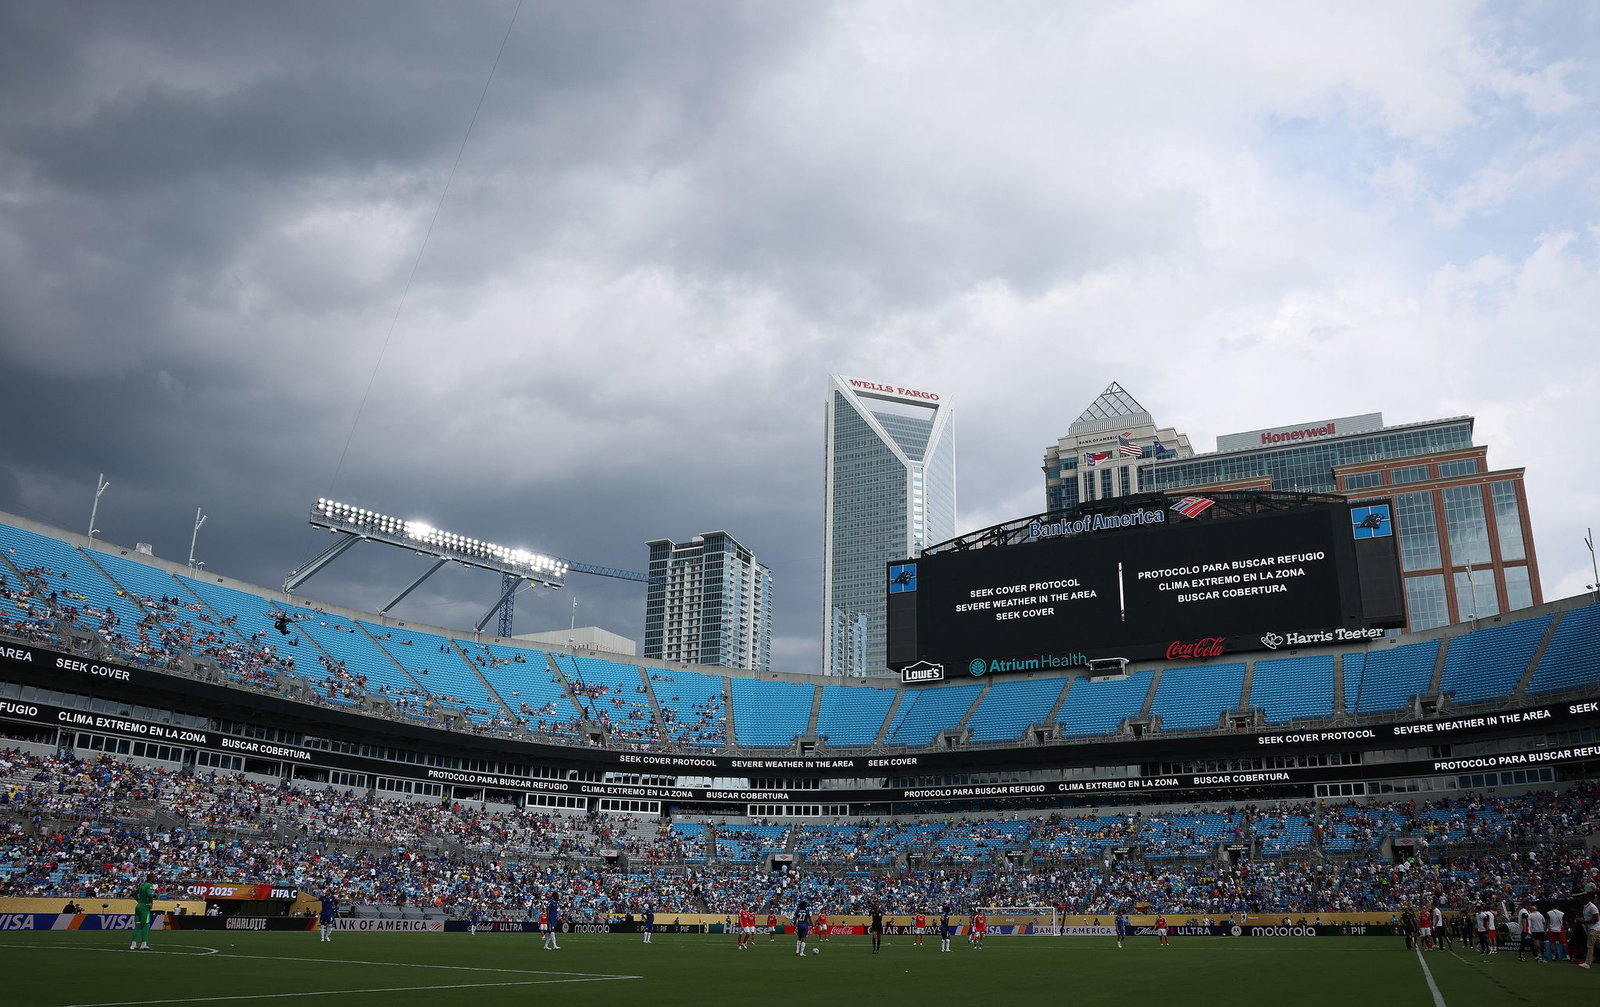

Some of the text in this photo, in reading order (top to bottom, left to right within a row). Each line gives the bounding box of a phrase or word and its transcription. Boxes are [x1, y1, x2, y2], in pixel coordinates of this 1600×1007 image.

[849, 379, 939, 401] WELLS FARGO
[1261, 422, 1335, 444] Honeywell
[1029, 509, 1165, 538] Bank of America
[1138, 552, 1325, 580] PROTOCOLO PARA BUSCAR REFUGIO
[1159, 568, 1305, 591] CLIMA EXTREMO EN LA ZONA
[970, 579, 1080, 598] SEEK COVER PROTOCOL
[1178, 584, 1287, 602] BUSCAR COBERTURA
[956, 590, 1097, 612] SEVERE WEATHER IN THE AREA
[996, 607, 1054, 621] SEEK COVER
[1286, 628, 1384, 646] Harris Teeter
[0, 646, 32, 662] AREA
[1165, 637, 1226, 660] Coca-Cola
[56, 658, 130, 681] SEEK COVER
[989, 652, 1088, 673] Atrium Health
[905, 667, 940, 680] LOWE'S
[1569, 702, 1599, 714] SEEK
[58, 711, 206, 743] CLIMA EXTREMO EN LA ZONA
[1394, 710, 1551, 735] SEVERE WEATHER IN THE AREA
[1258, 730, 1376, 744] SEEK COVER PROTOCOL
[222, 737, 312, 761] BUSCAR COBERTURA
[620, 755, 717, 766] SEEK COVER PROTOCOL
[732, 760, 763, 768] SEVERE
[868, 758, 917, 767] SEEK COVER
[1434, 758, 1496, 770] PROTOCOLO
[1499, 755, 1527, 765] PARA
[1528, 750, 1572, 762] BUSCAR
[428, 770, 568, 791] PROTOCOLO PARA BUSCAR REFUGIO
[1058, 783, 1084, 791] CLIMA
[1086, 781, 1126, 790] EXTREMO
[1128, 780, 1139, 788] EN
[1154, 778, 1179, 786] ZONA
[1194, 772, 1290, 784] BUSCAR COBERTURA
[581, 785, 605, 793] CLIMA
[607, 787, 645, 795] EXTREMO
[706, 791, 789, 800] BUSCAR COBERTURA
[904, 789, 951, 797] PROTOCOLO
[974, 786, 1008, 795] BUSCAR
[1009, 785, 1045, 793] REFUGIO
[187, 886, 208, 896] CUP
[271, 888, 290, 899] FIFA
[98, 914, 136, 930] VISA
[226, 917, 268, 930] CHARLOTTE
[797, 912, 807, 921] 27
[331, 920, 428, 931] ANK OF AMERICA
[500, 922, 523, 932] ULTRA
[574, 923, 610, 934] motorola
[1177, 926, 1211, 936] ULTRA
[1251, 925, 1316, 937] motorola
[1351, 926, 1367, 936] PIF
